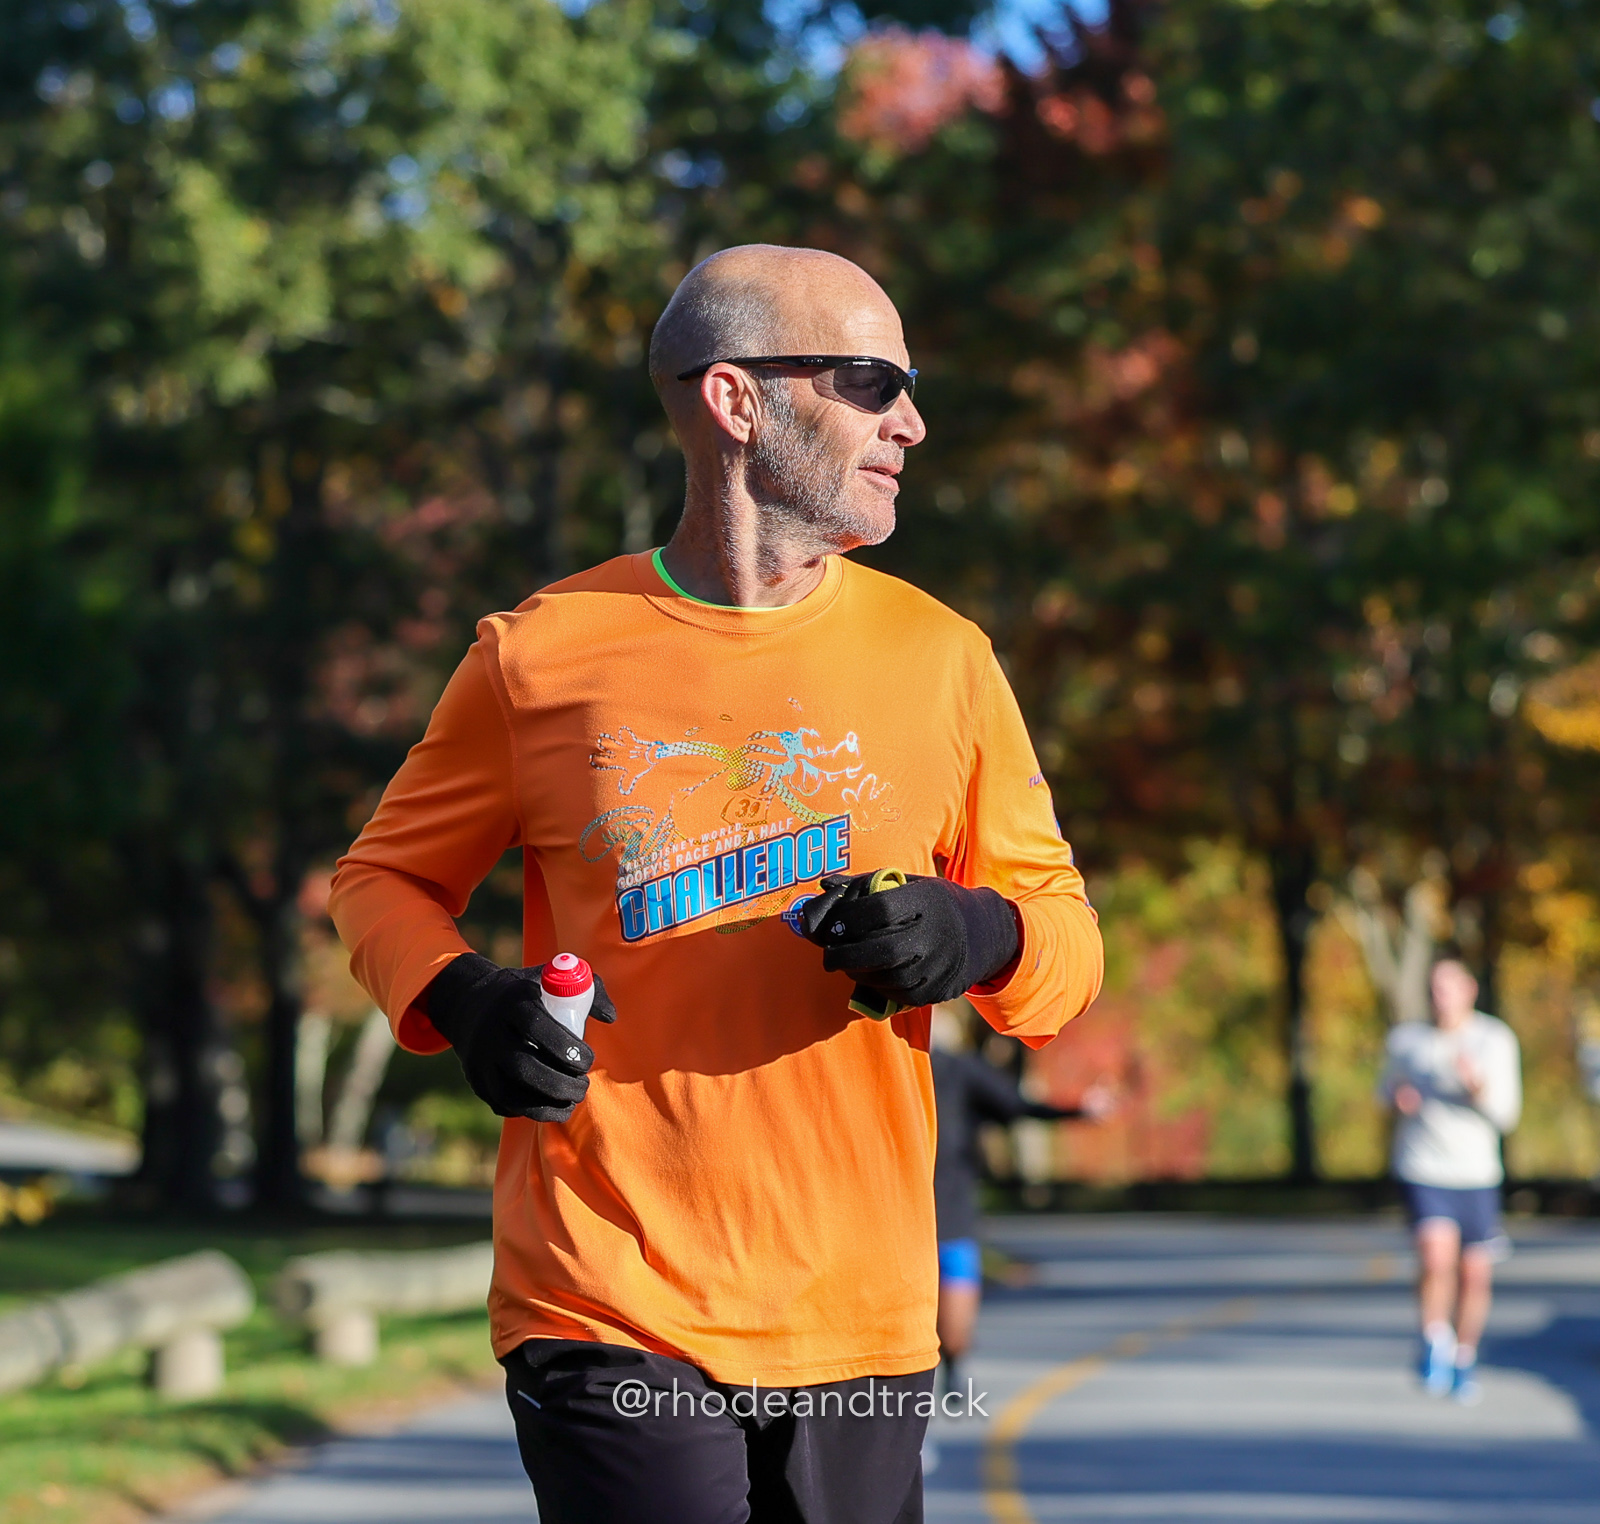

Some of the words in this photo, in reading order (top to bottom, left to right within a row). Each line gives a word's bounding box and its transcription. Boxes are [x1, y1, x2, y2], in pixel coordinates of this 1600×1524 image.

[616, 858, 671, 890] GOOFY'S
[675, 844, 711, 868] RACE
[714, 834, 742, 854] AND
[746, 829, 756, 844] A
[760, 817, 794, 839] HALF
[618, 816, 849, 941] CHALLENGE
[651, 838, 695, 862] DISNEY
